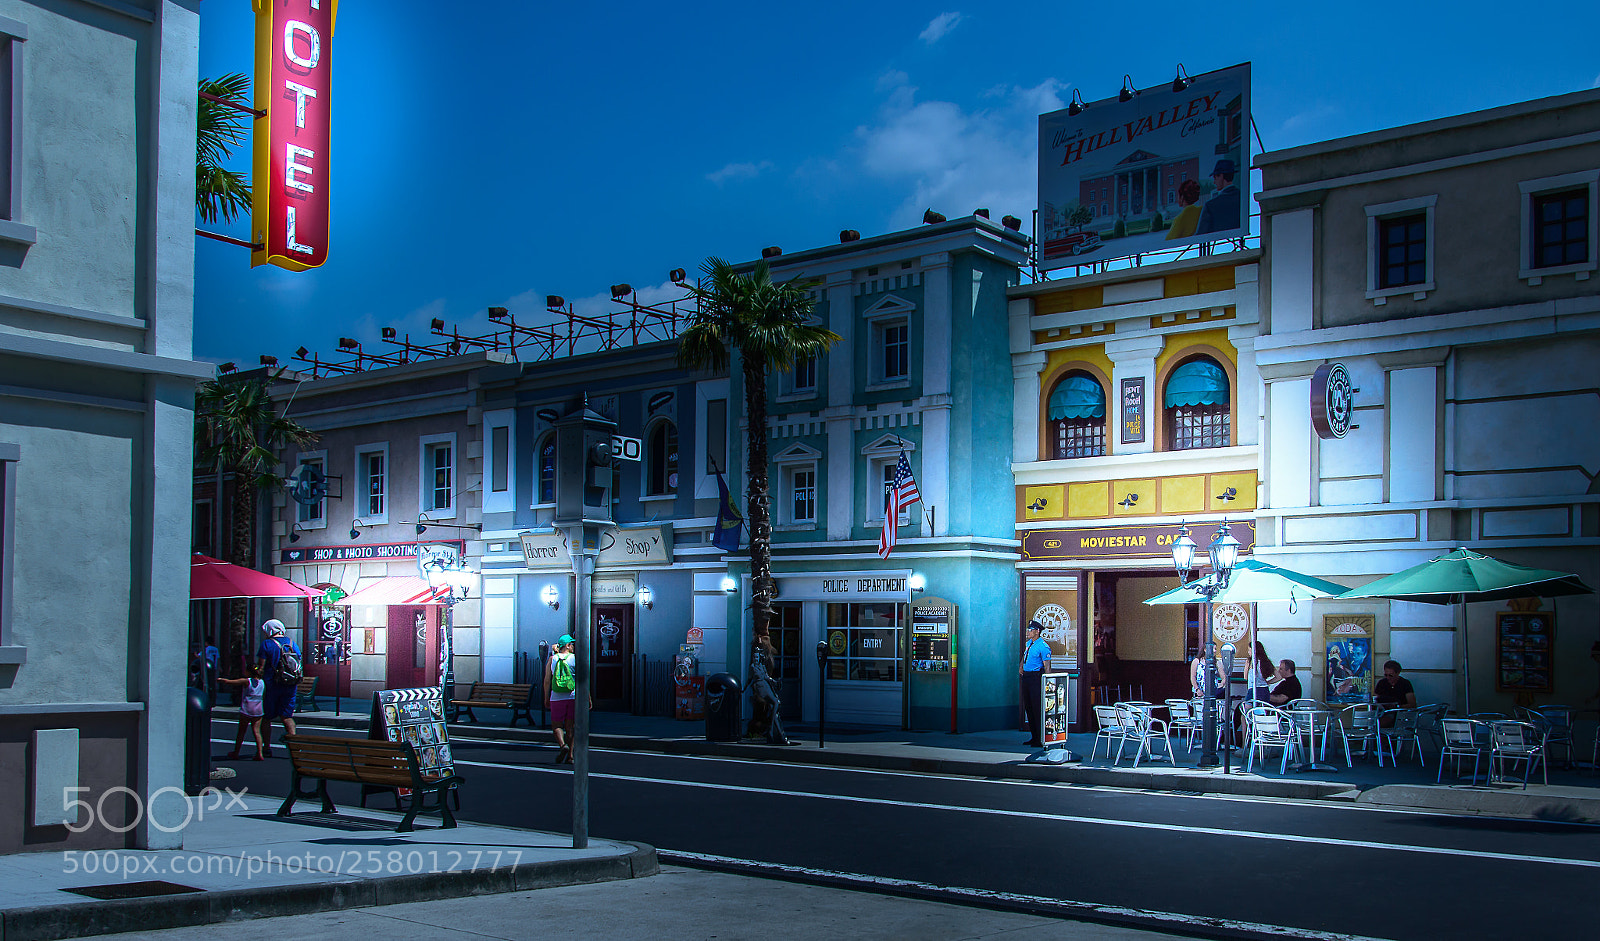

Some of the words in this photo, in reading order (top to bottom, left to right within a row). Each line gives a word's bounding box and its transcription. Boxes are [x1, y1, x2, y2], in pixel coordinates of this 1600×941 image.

[283, 0, 320, 255] OTEL
[1060, 126, 1123, 167] HILL
[525, 543, 558, 559] Horror
[625, 537, 651, 557] Shop
[1080, 536, 1146, 548] MOVIESTAR
[313, 549, 334, 560] SHOP
[336, 549, 343, 559] &
[345, 547, 373, 558] PHOTO
[377, 544, 418, 557] SHOOTING
[822, 579, 849, 593] POLICE
[857, 578, 907, 592] DEPARTMENT
[1037, 606, 1068, 621] MOVIESTAR
[1215, 605, 1246, 620] MOVIESTAR
[863, 638, 883, 648] ENTRY
